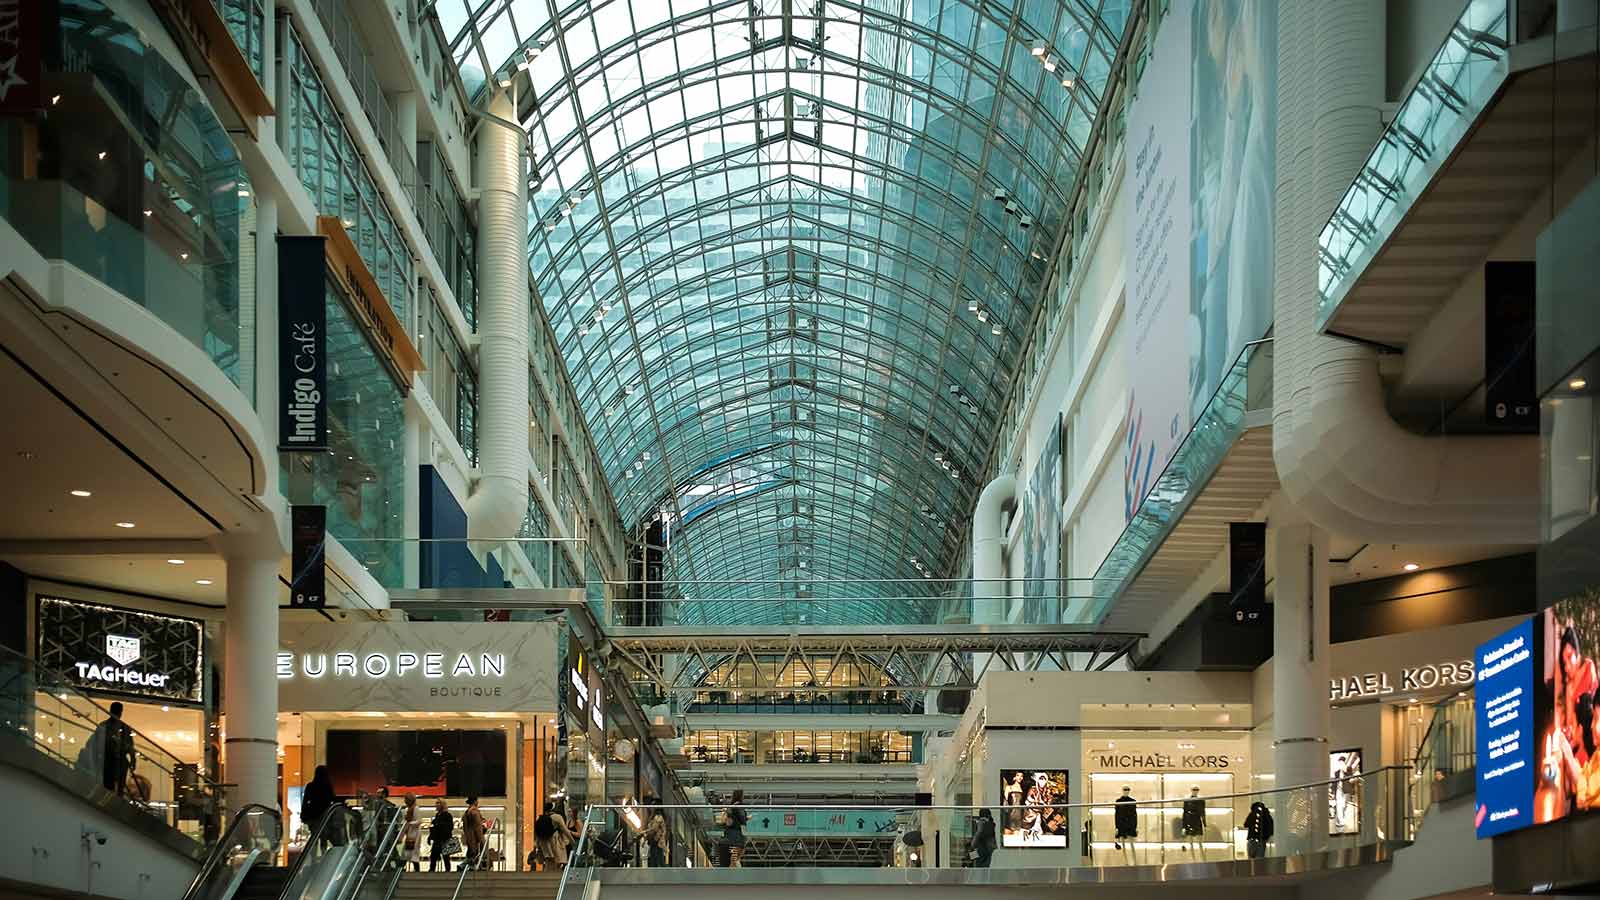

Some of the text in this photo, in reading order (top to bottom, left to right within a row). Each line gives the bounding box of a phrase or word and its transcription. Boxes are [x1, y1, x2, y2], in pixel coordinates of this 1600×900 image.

[291, 321, 316, 373] Café
[276, 652, 505, 677] EUROPEAN
[1402, 660, 1475, 690] KORS
[430, 687, 503, 697] BOUTIQUE
[1100, 755, 1229, 768] MICHAEL KORS
